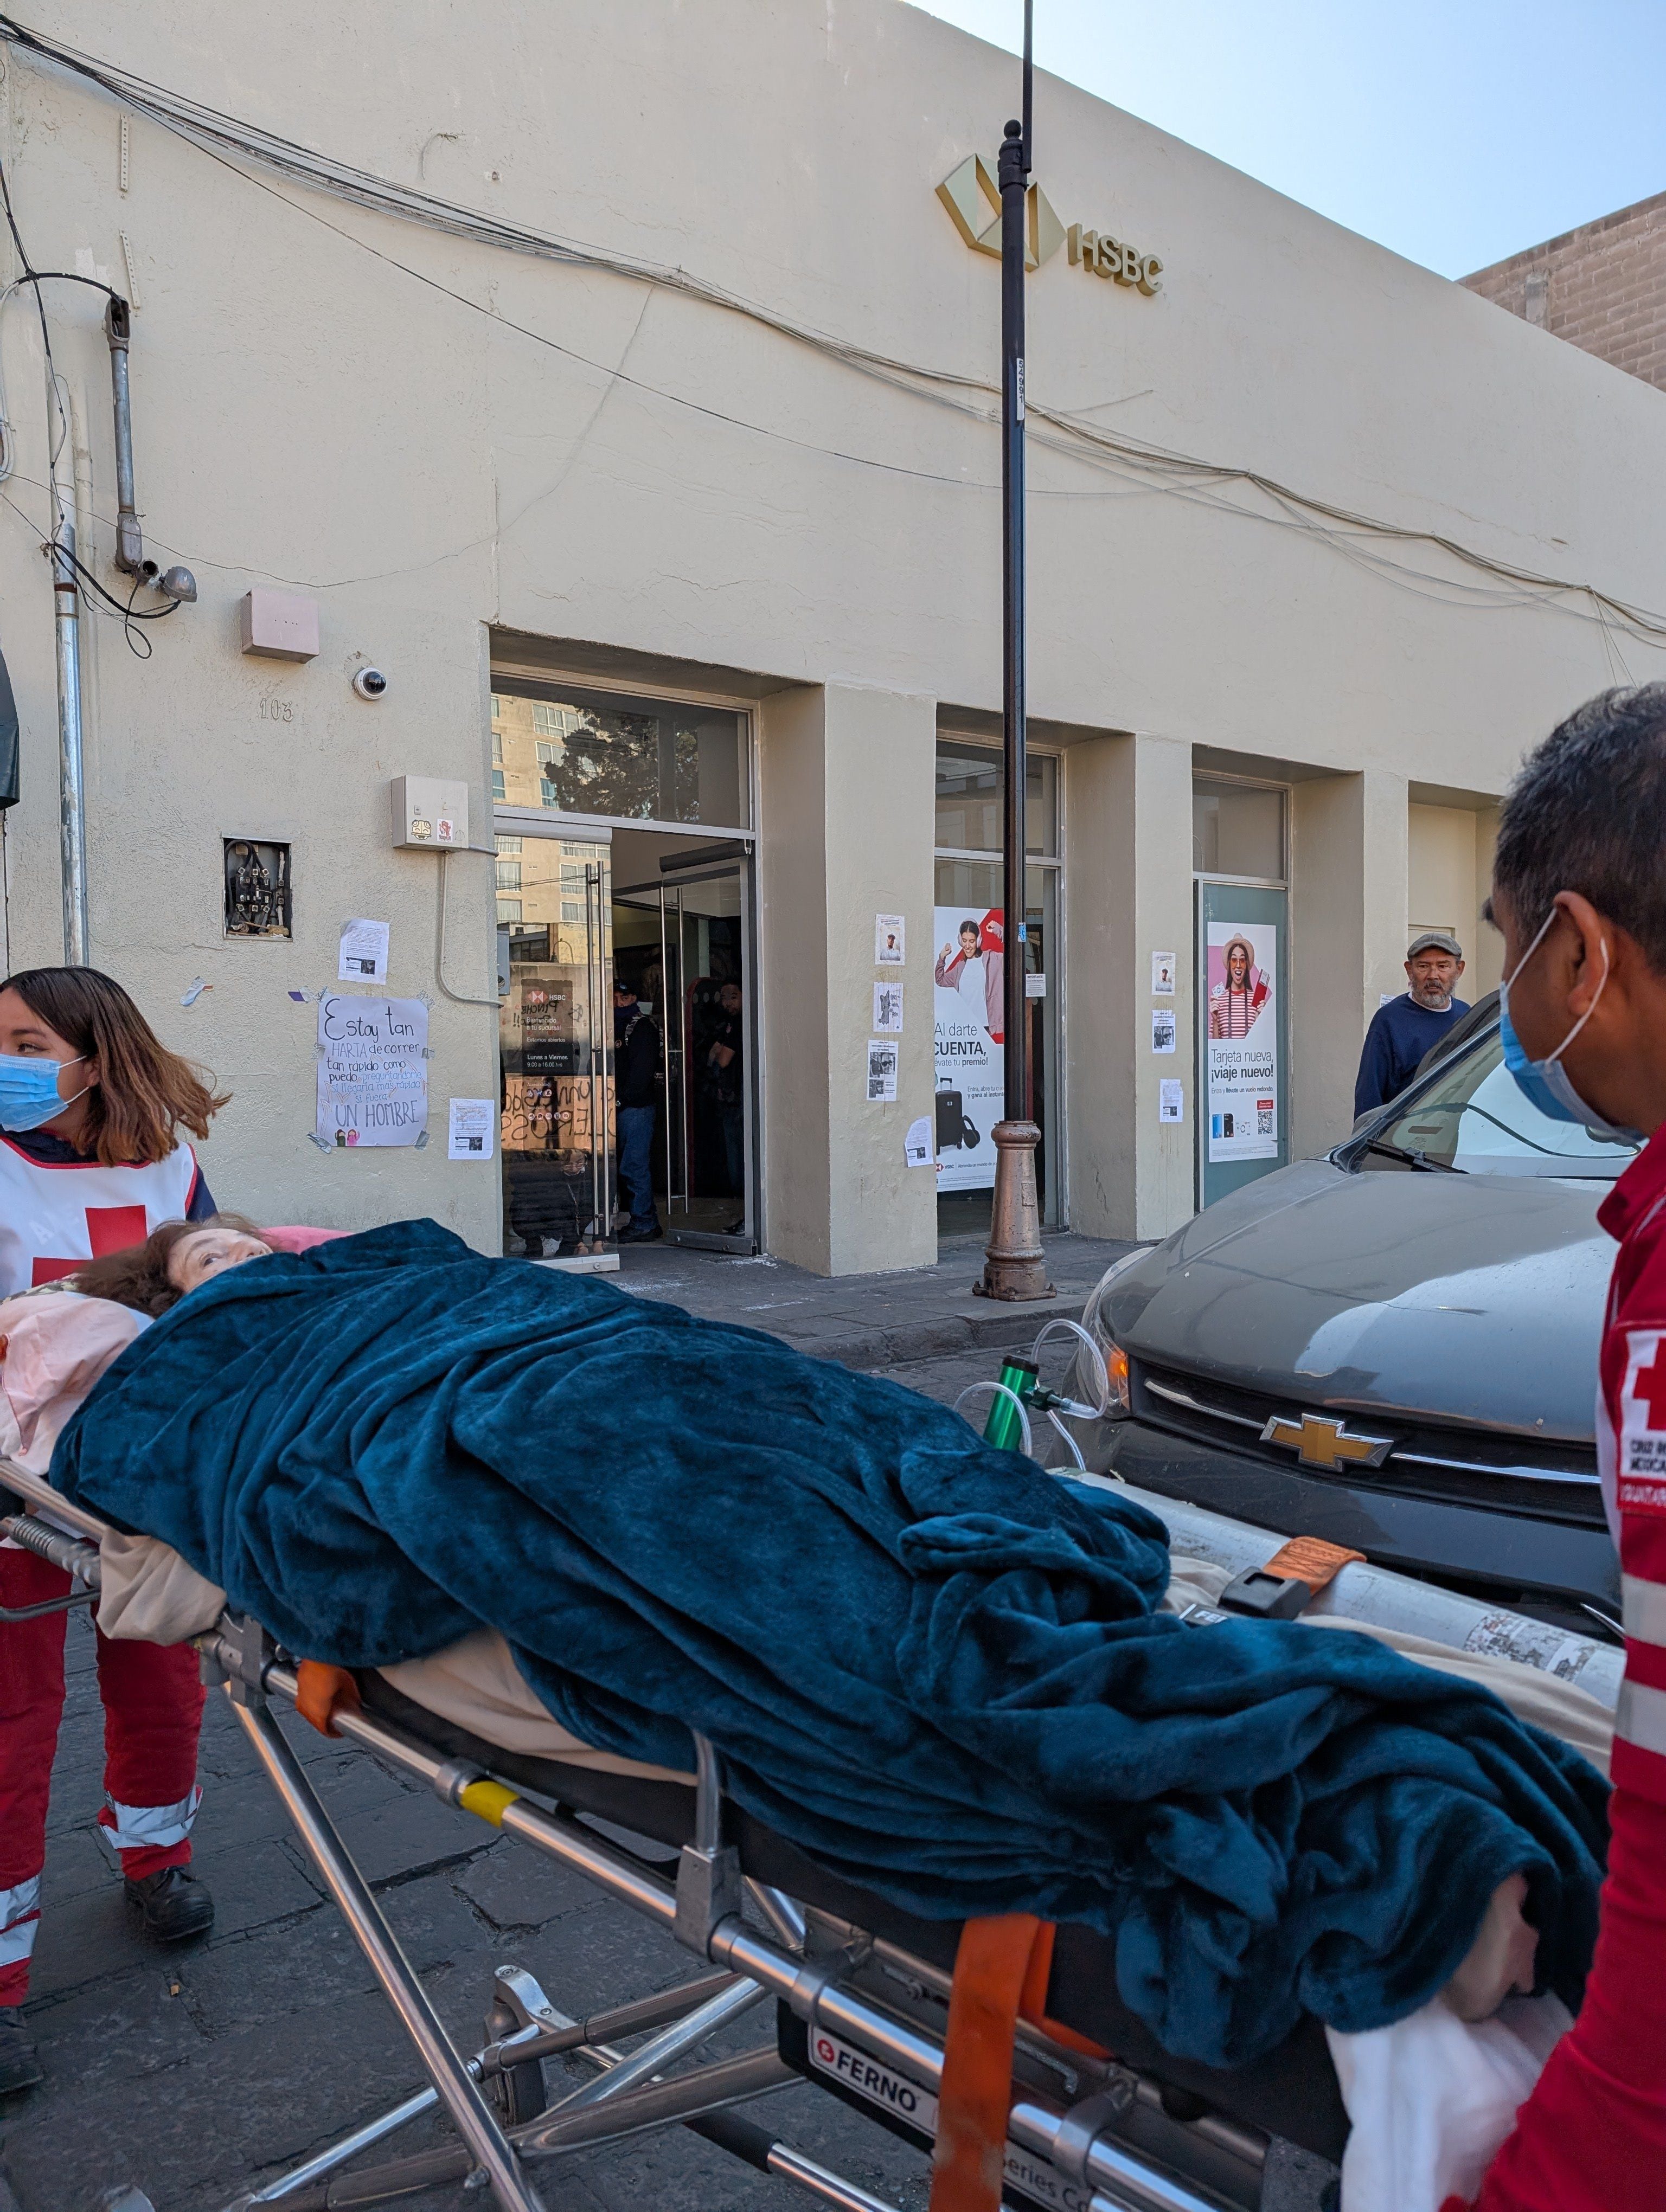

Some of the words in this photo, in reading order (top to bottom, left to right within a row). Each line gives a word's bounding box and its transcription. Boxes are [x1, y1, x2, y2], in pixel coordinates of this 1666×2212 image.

[1067, 223, 1163, 296] HSBC
[260, 698, 293, 722] 103
[385, 1006, 414, 1036] tan
[935, 1022, 945, 1036] Al
[949, 1022, 977, 1036] darte
[332, 1043, 367, 1058] HARTA
[369, 1044, 382, 1054] de
[384, 1044, 420, 1054] correr
[1211, 1049, 1241, 1066] Tarjeta
[1245, 1051, 1273, 1064] nueva,
[326, 1057, 344, 1072] tan
[383, 1060, 406, 1070] como
[954, 1058, 960, 1066] tu
[962, 1057, 988, 1068] premio!
[329, 1072, 358, 1084] puedo
[1212, 1065, 1238, 1083] ¡viaje
[1241, 1064, 1273, 1078] nuevo!
[355, 1095, 362, 1103] si
[366, 1092, 388, 1103] fuera
[335, 1104, 358, 1127] UN
[365, 1099, 419, 1128] HOMBRE
[837, 2048, 917, 2113] FERNO
[1003, 2158, 1057, 2200] eries
